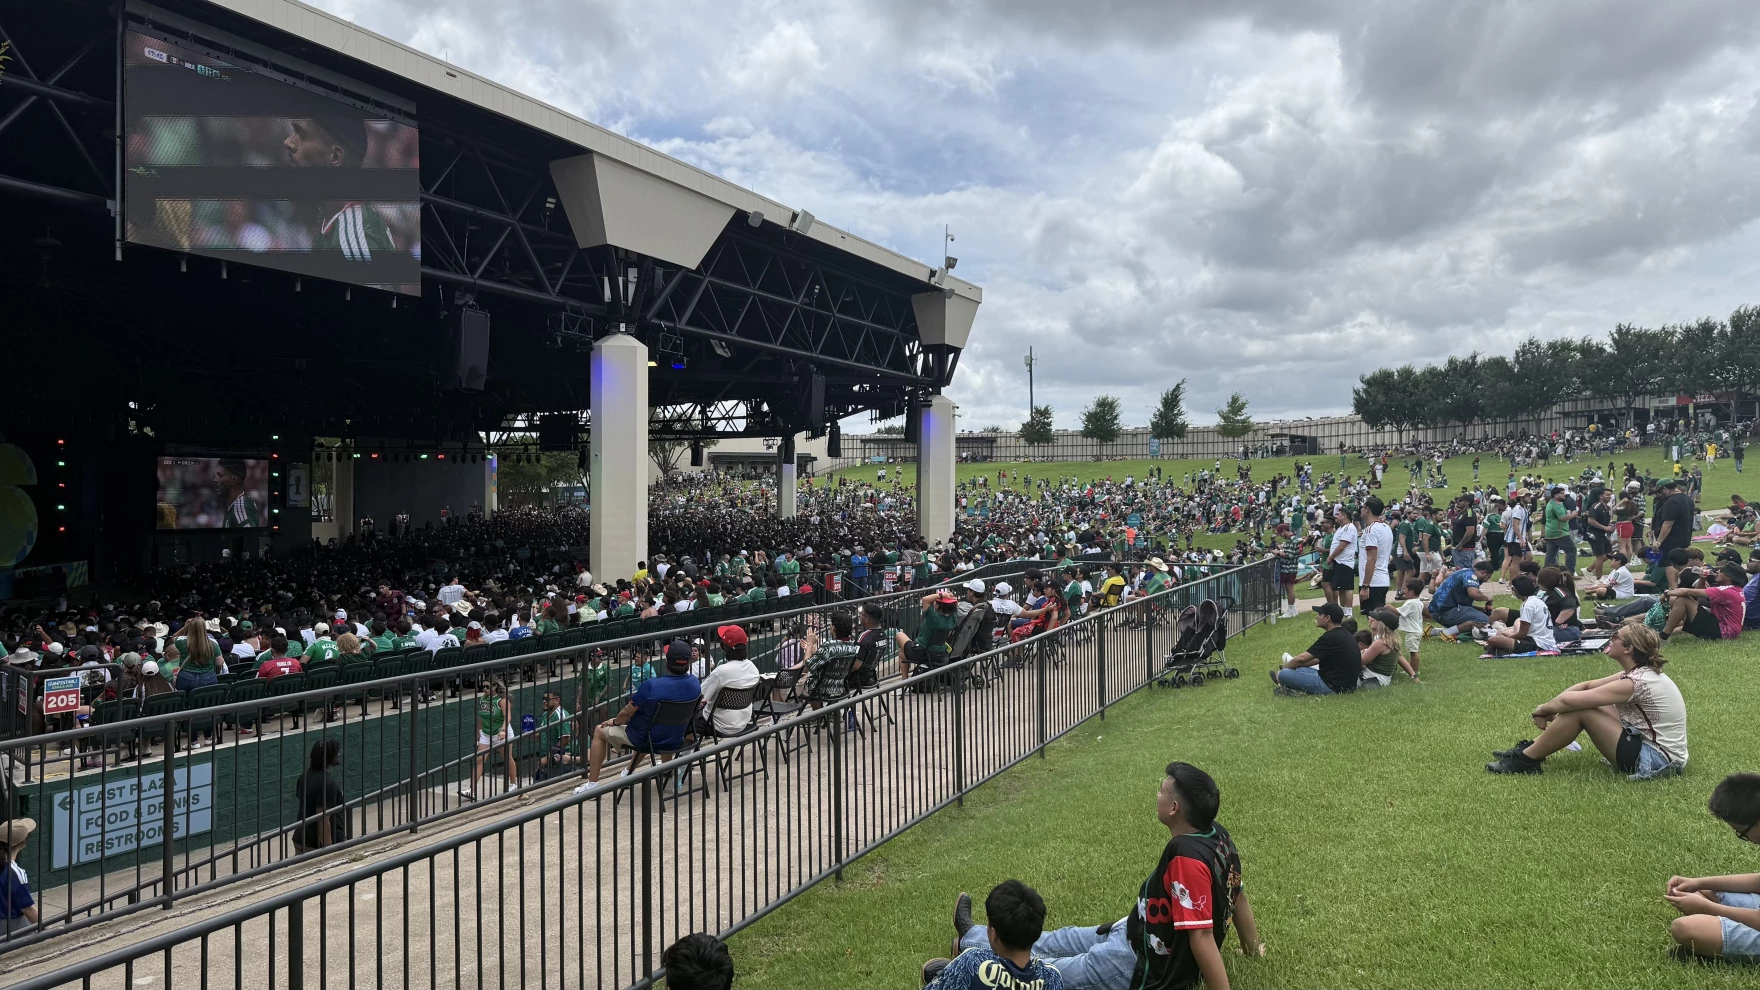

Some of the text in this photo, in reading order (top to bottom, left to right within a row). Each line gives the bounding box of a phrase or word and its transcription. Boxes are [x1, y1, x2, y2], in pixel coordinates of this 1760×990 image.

[47, 693, 77, 709] 205
[85, 786, 126, 805] EAST
[85, 810, 130, 830] FOOD
[147, 793, 200, 816] DRNKS
